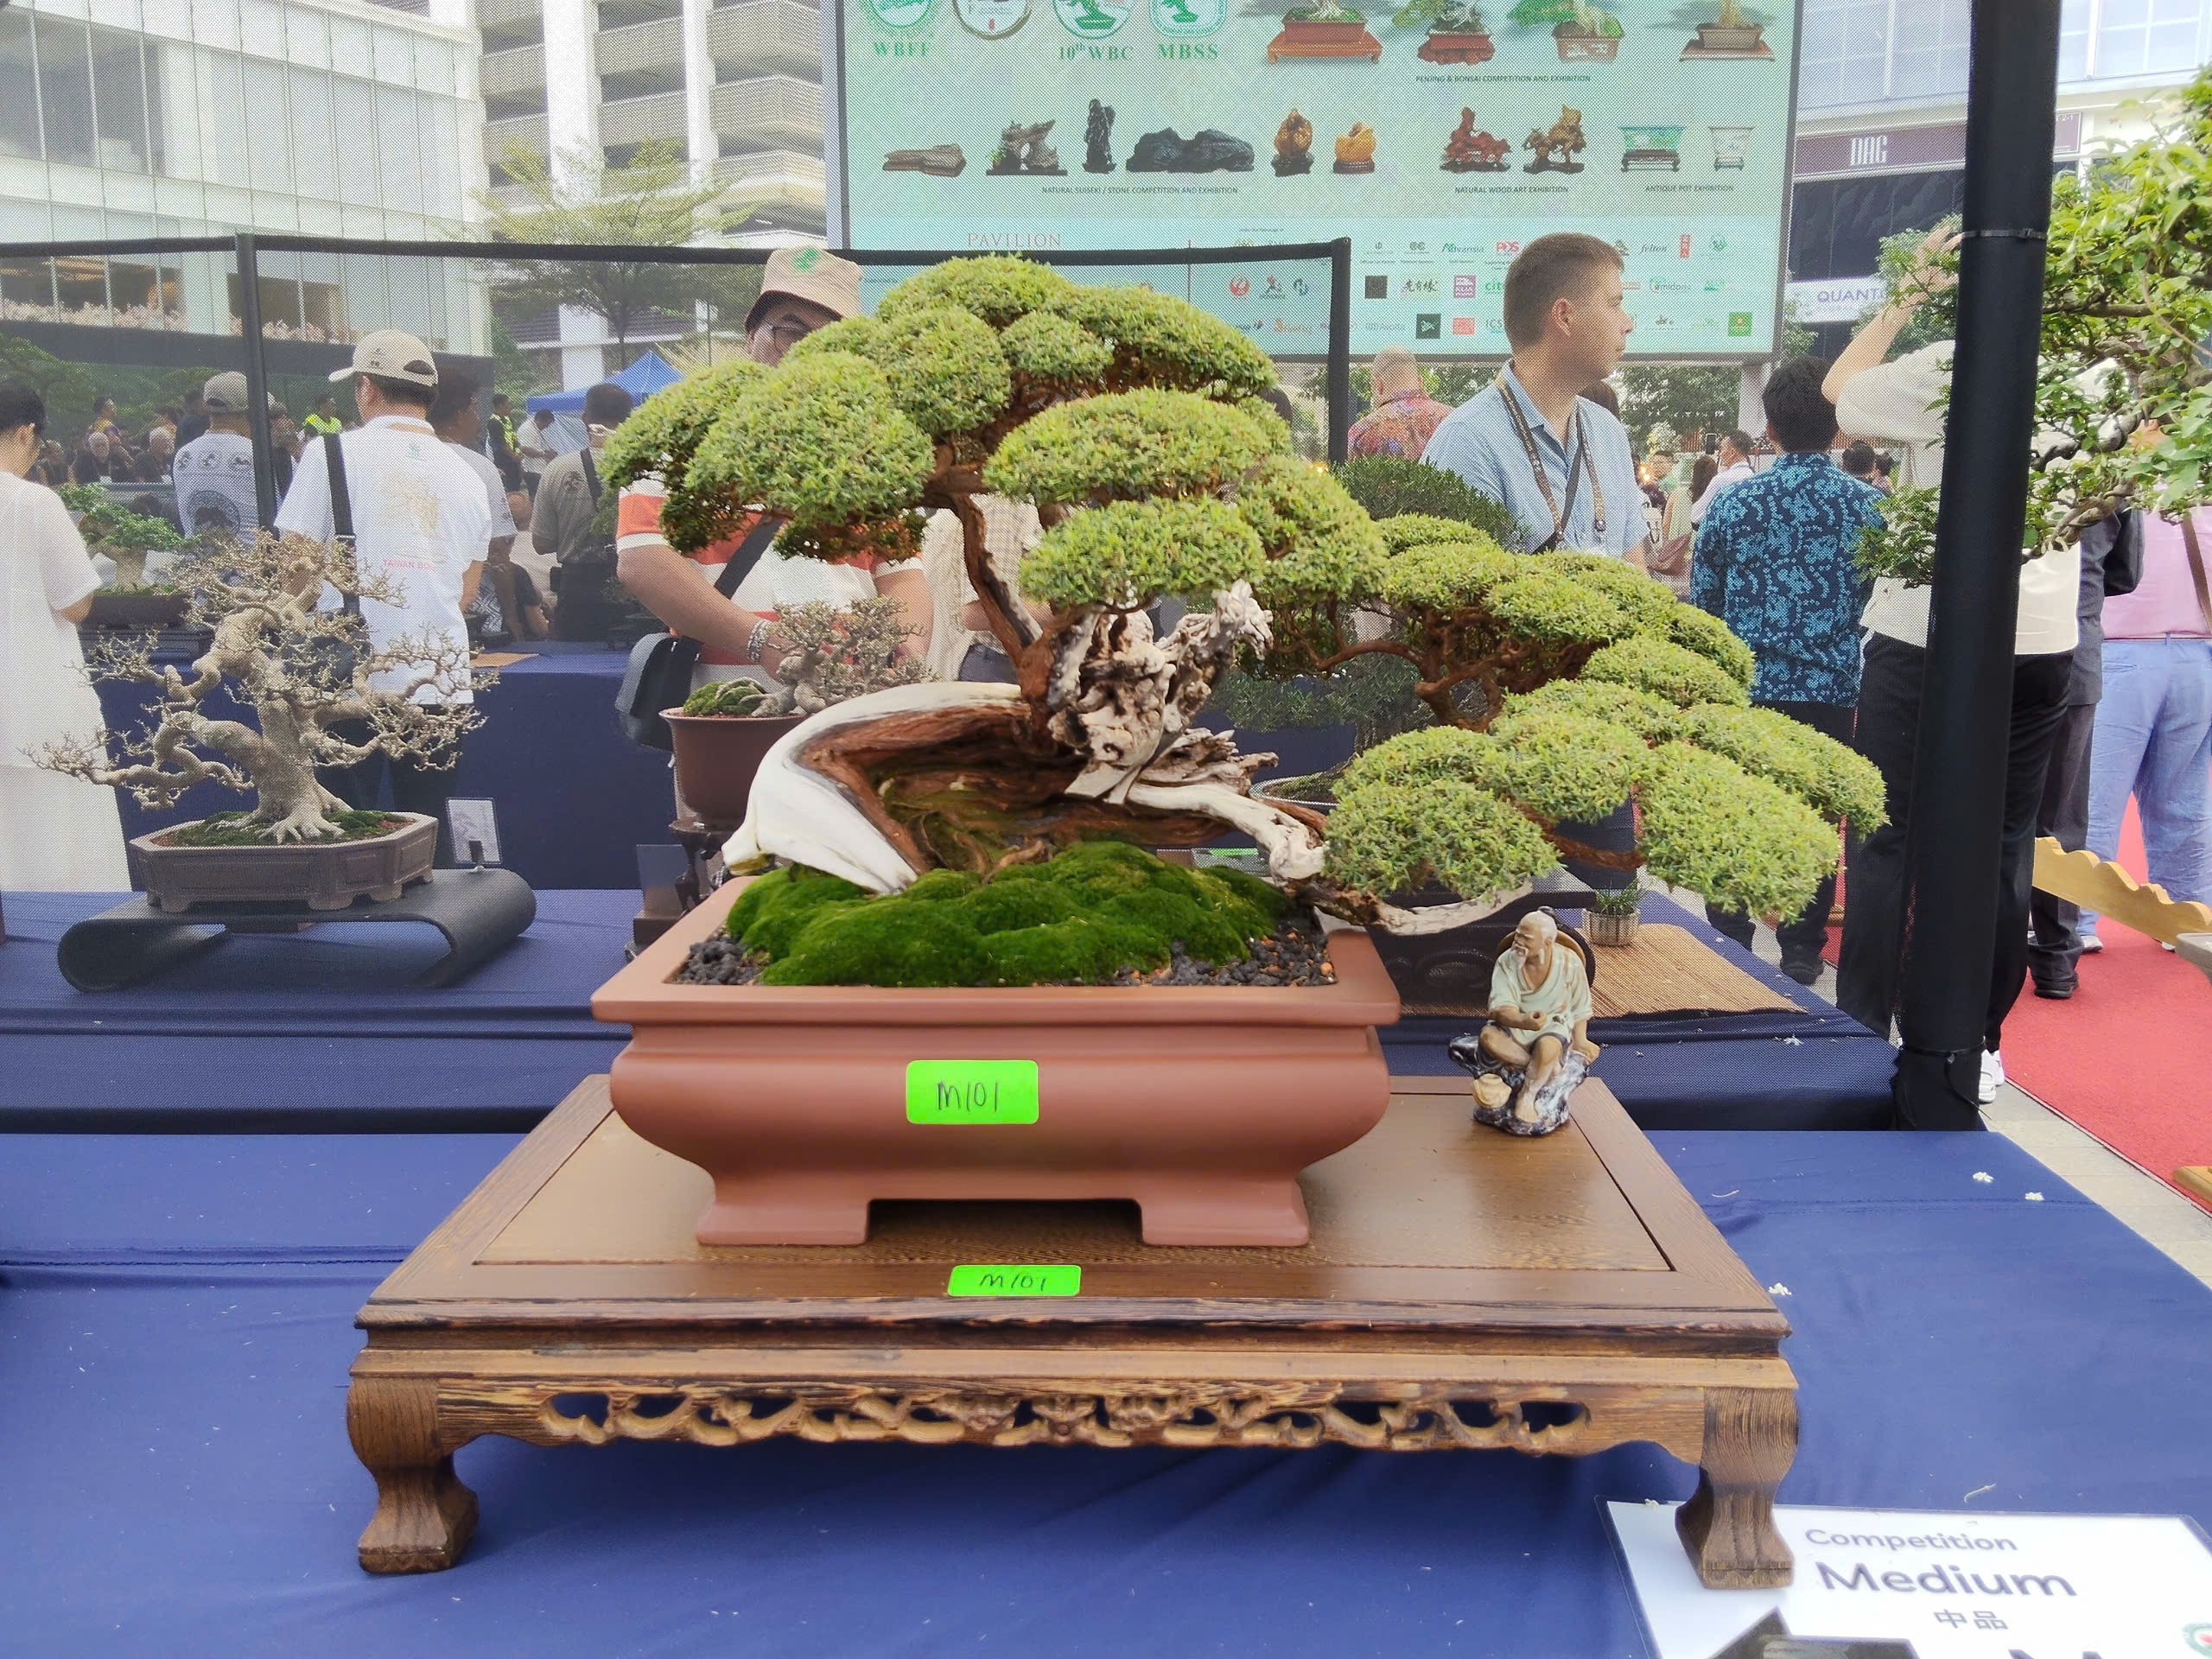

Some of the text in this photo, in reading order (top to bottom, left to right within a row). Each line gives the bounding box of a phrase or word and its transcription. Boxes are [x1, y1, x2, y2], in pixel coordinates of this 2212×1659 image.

[1088, 46, 1134, 61] WBC
[1158, 44, 1218, 60] MBSS
[1849, 135, 1888, 167] DAG
[967, 233, 1061, 248] PAVILION
[938, 1082, 998, 1112] M101
[980, 1274, 1046, 1292] M101
[1805, 1529, 2018, 1552] Competition
[1815, 1562, 2077, 1597] Medium
[1934, 1609, 2009, 1630] 中品
